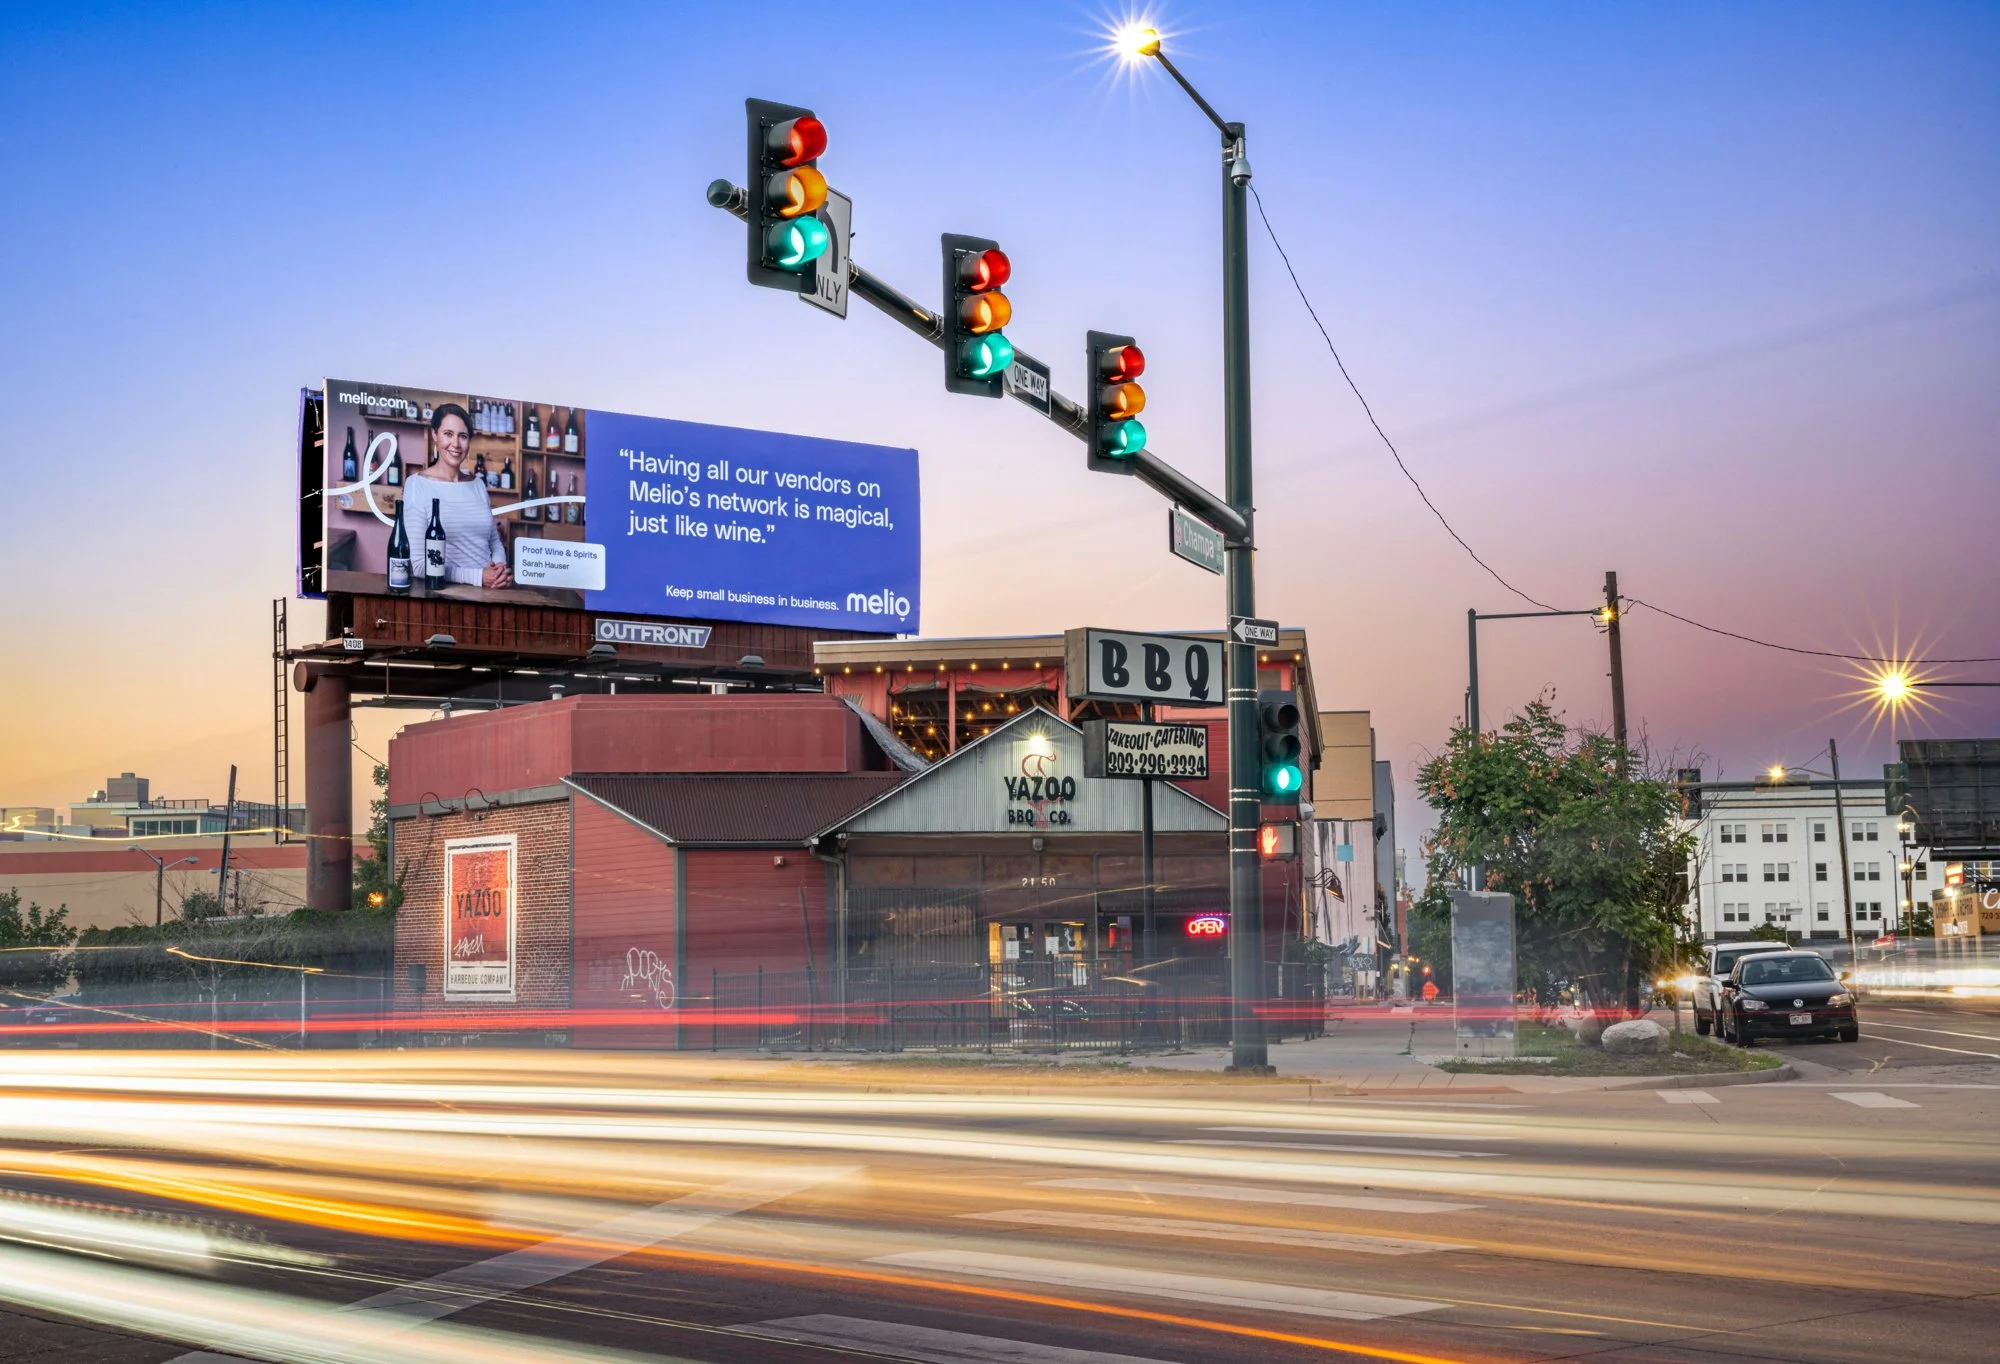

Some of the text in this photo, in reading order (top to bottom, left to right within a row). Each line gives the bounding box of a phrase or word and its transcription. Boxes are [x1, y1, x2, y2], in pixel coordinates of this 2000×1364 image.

[816, 274, 842, 304] NLY
[1014, 364, 1046, 397] ONE WAY
[339, 391, 409, 410] melio.com
[707, 459, 729, 481] all
[736, 467, 769, 486] our
[775, 471, 852, 495] vendors
[857, 481, 881, 499] on
[628, 510, 669, 536] just
[675, 514, 709, 538] like
[707, 492, 789, 517] network
[794, 497, 810, 519] is
[816, 505, 894, 531] magical,
[522, 545, 598, 560] Proof Wine & Spirits
[1183, 520, 1215, 561] Champa
[522, 559, 570, 570] Sarah Hauser
[522, 569, 546, 578] Owner
[666, 585, 840, 611] Keep small business in business.
[846, 588, 911, 622] melio
[344, 639, 362, 649] 1408
[600, 622, 705, 645] OUTFRONT
[1245, 626, 1274, 639] ONE WAY
[1098, 639, 1210, 701] BBQ
[1003, 776, 1076, 801] YAZOO
[1008, 809, 1072, 827] BBQ CO.
[456, 887, 502, 920] YAZOO
[1188, 921, 1223, 934] OPEN
[480, 973, 508, 985] COMPANY
